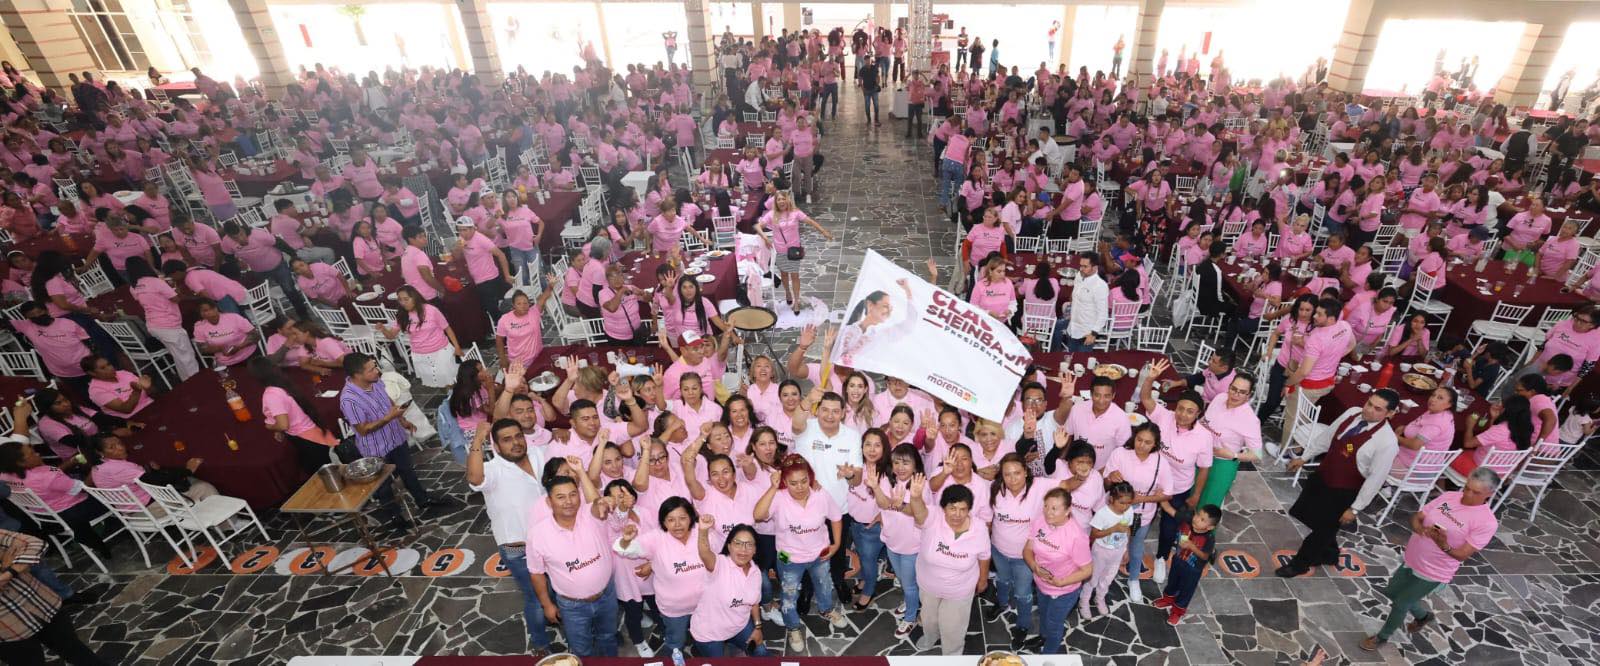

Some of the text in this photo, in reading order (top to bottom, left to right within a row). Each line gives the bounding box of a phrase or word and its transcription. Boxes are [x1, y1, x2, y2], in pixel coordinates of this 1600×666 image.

[944, 325, 1003, 366] PRESIDENTA
[926, 375, 964, 398] morena
[242, 550, 269, 569] 2
[432, 553, 454, 571] 5
[565, 557, 580, 568] Red
[673, 560, 687, 569] Red
[1222, 555, 1256, 574] 19
